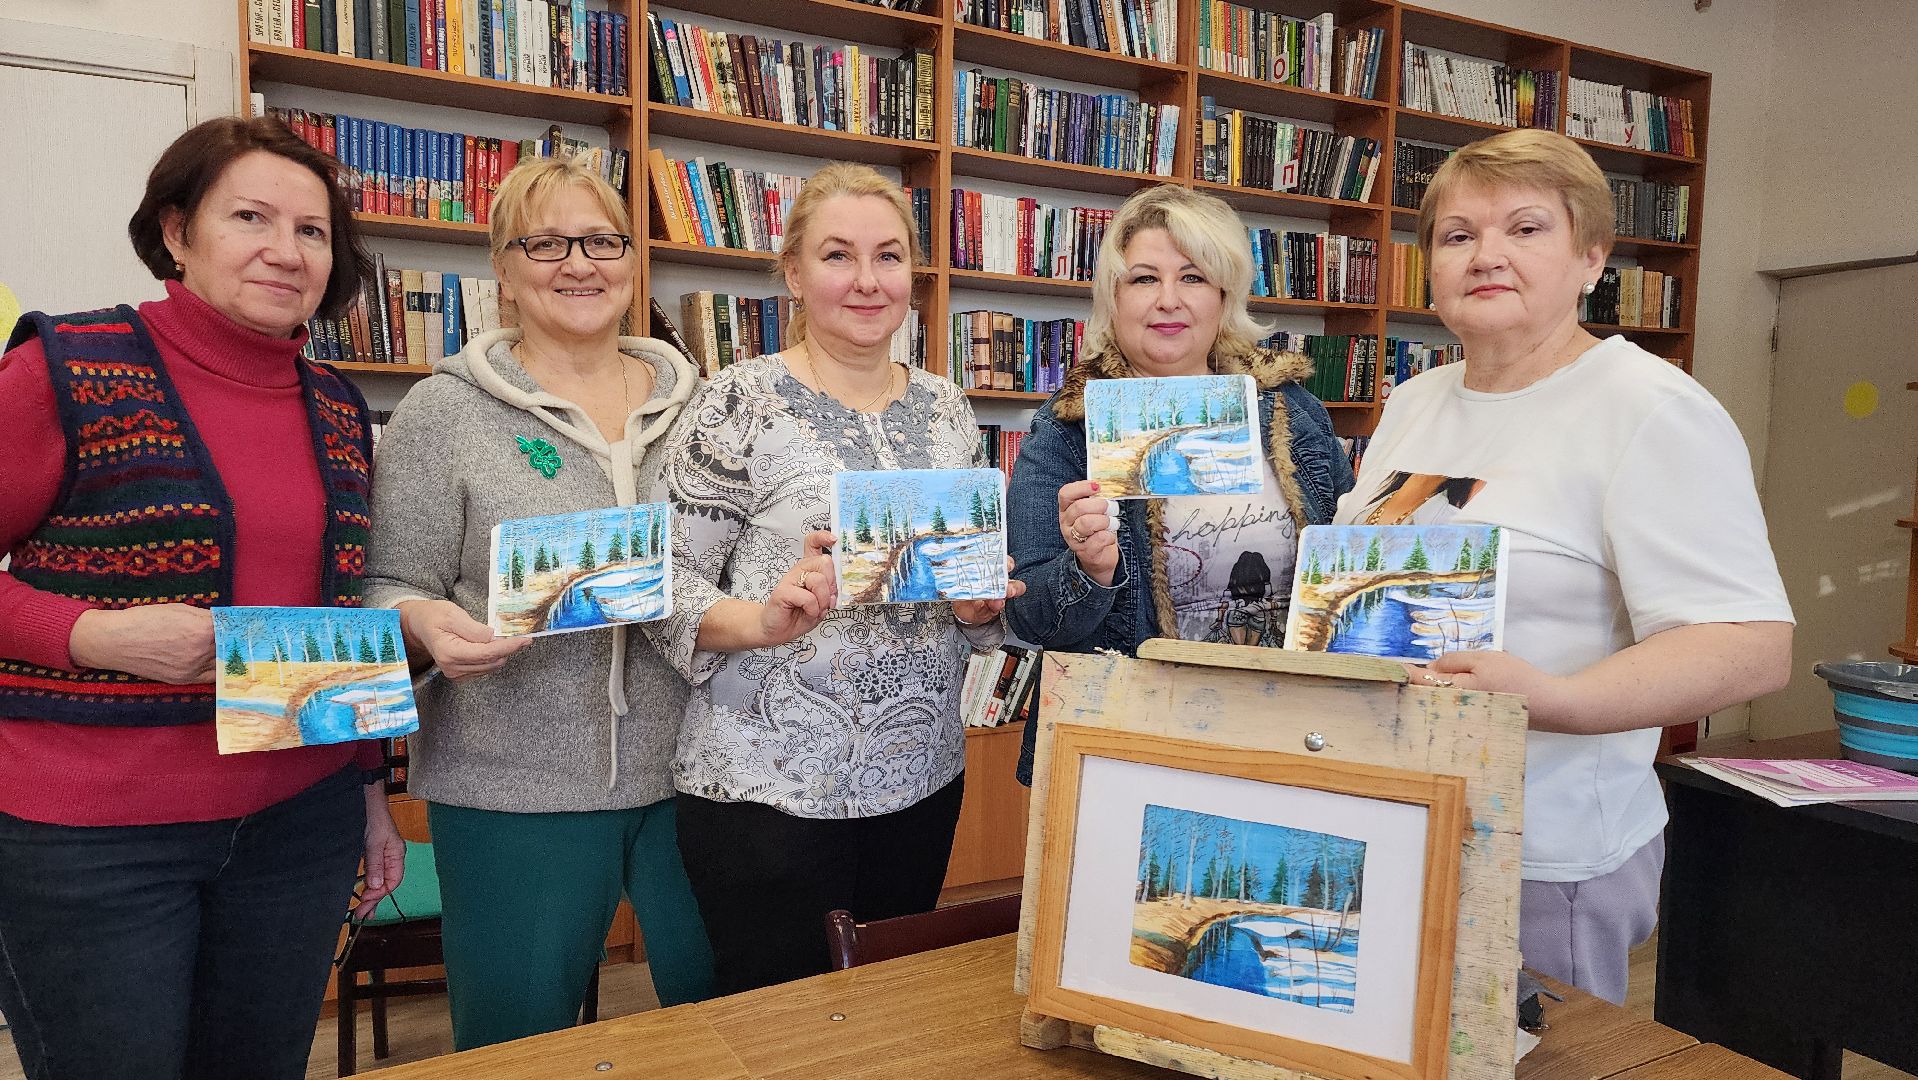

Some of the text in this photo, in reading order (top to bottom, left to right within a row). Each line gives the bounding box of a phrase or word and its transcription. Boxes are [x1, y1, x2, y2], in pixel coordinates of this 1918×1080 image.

[1282, 164, 1295, 186] П
[1055, 255, 1067, 276] Л
[984, 701, 1000, 723] Н
